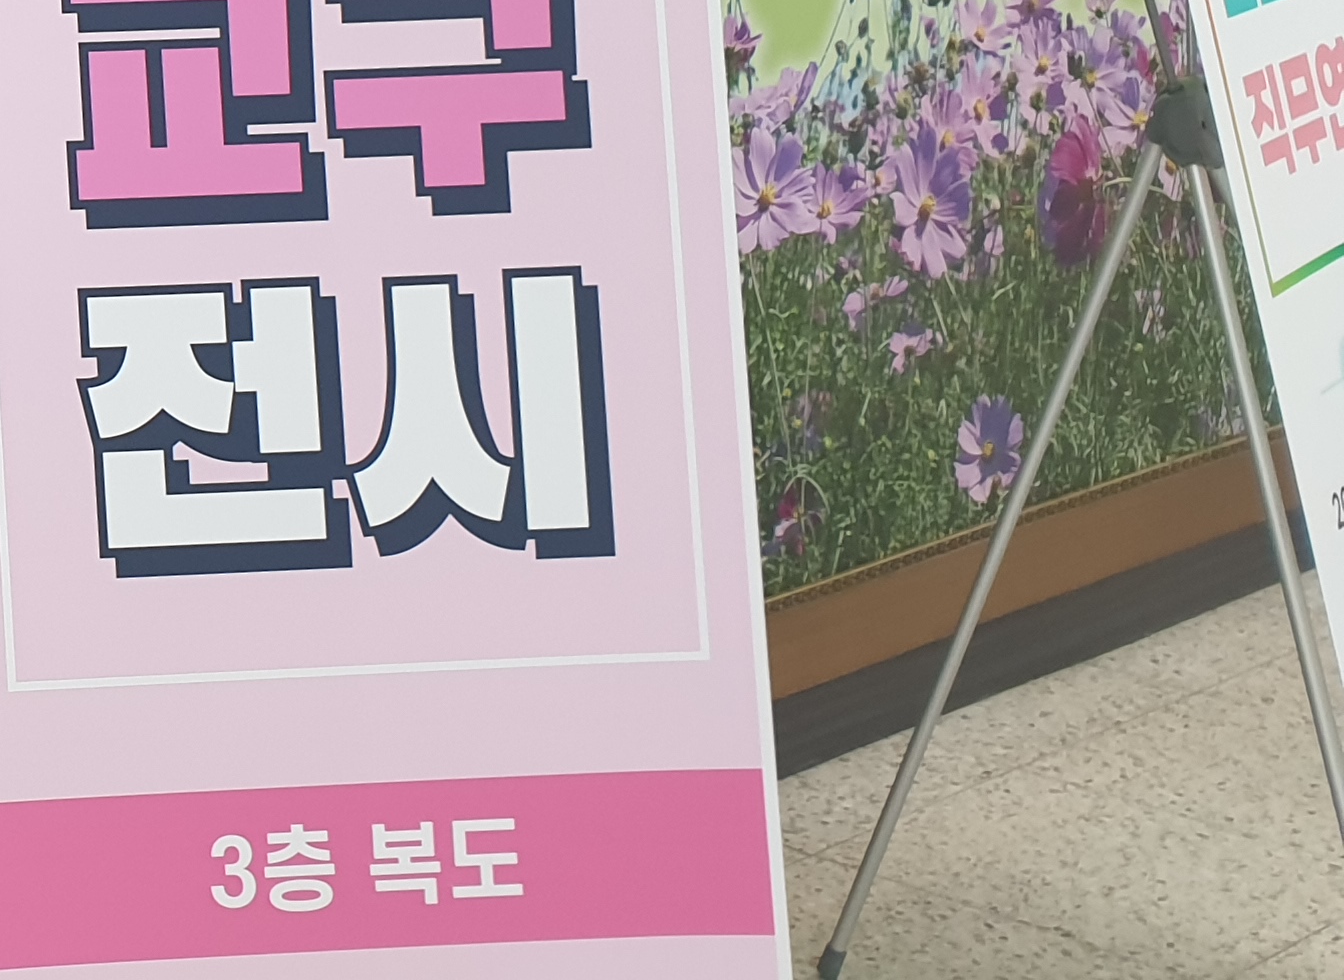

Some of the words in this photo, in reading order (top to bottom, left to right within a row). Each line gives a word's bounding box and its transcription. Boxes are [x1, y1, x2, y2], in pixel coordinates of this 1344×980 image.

[76, 266, 616, 579] 전시
[209, 823, 336, 912] 3층
[369, 817, 525, 905] 복도
